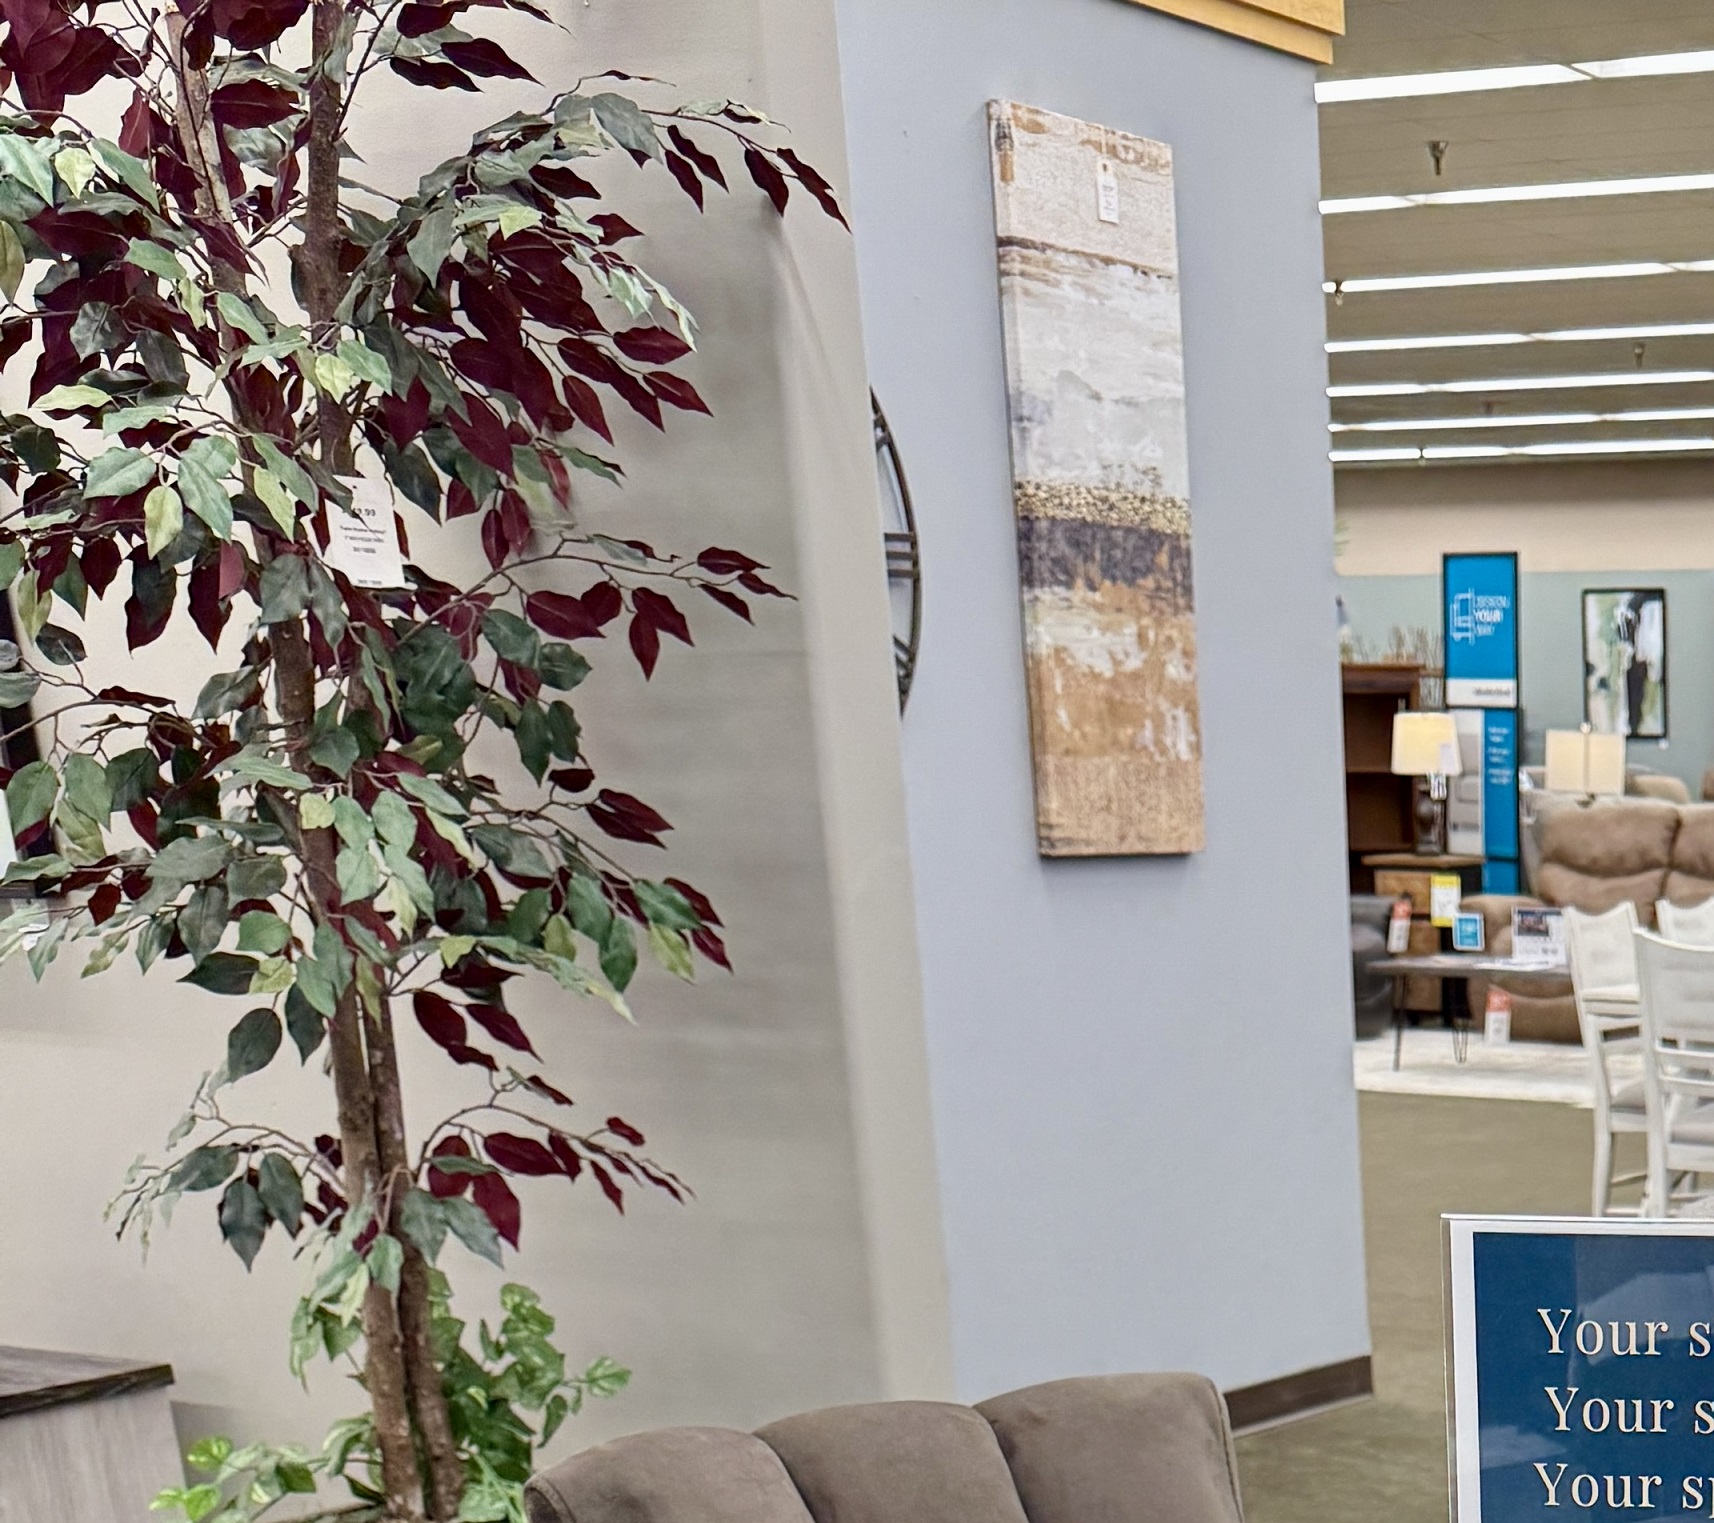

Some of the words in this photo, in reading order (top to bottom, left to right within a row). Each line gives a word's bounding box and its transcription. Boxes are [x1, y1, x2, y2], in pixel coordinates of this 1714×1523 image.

[1537, 1308, 1669, 1357] Your
[1544, 1386, 1675, 1433] Your
[1533, 1462, 1663, 1508] Your
